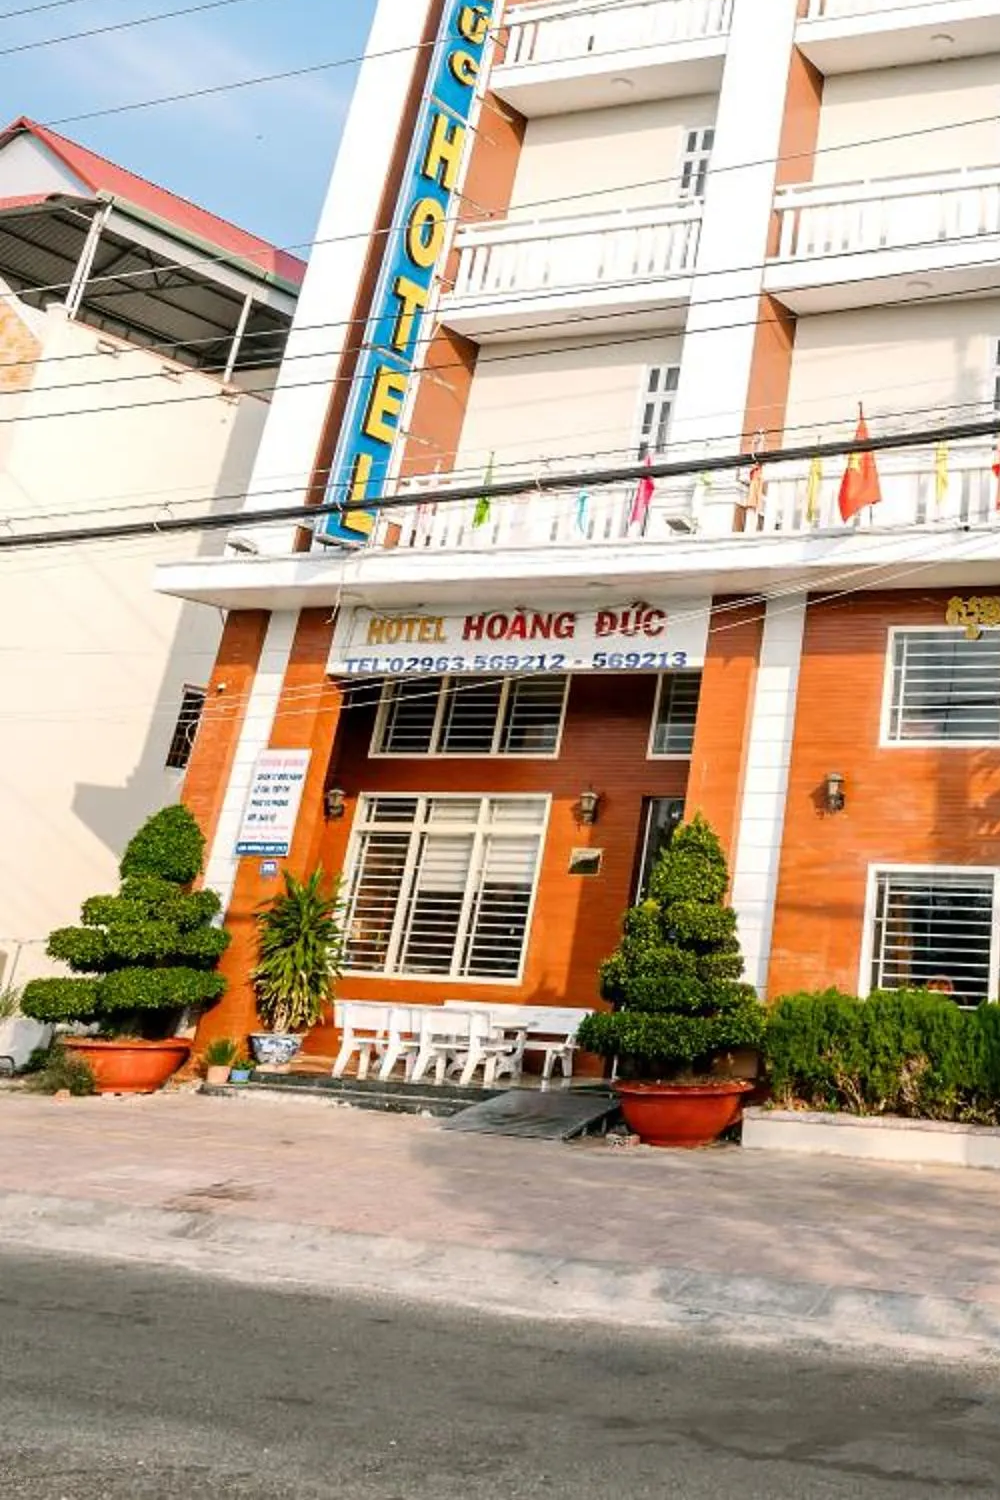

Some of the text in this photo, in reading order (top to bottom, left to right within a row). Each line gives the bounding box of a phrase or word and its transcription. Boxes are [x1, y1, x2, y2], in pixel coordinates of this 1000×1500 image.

[340, 113, 467, 538] HOTEL
[366, 598, 667, 645] HOTEL HOÀNG ĐỨC
[592, 651, 687, 669] 569213
